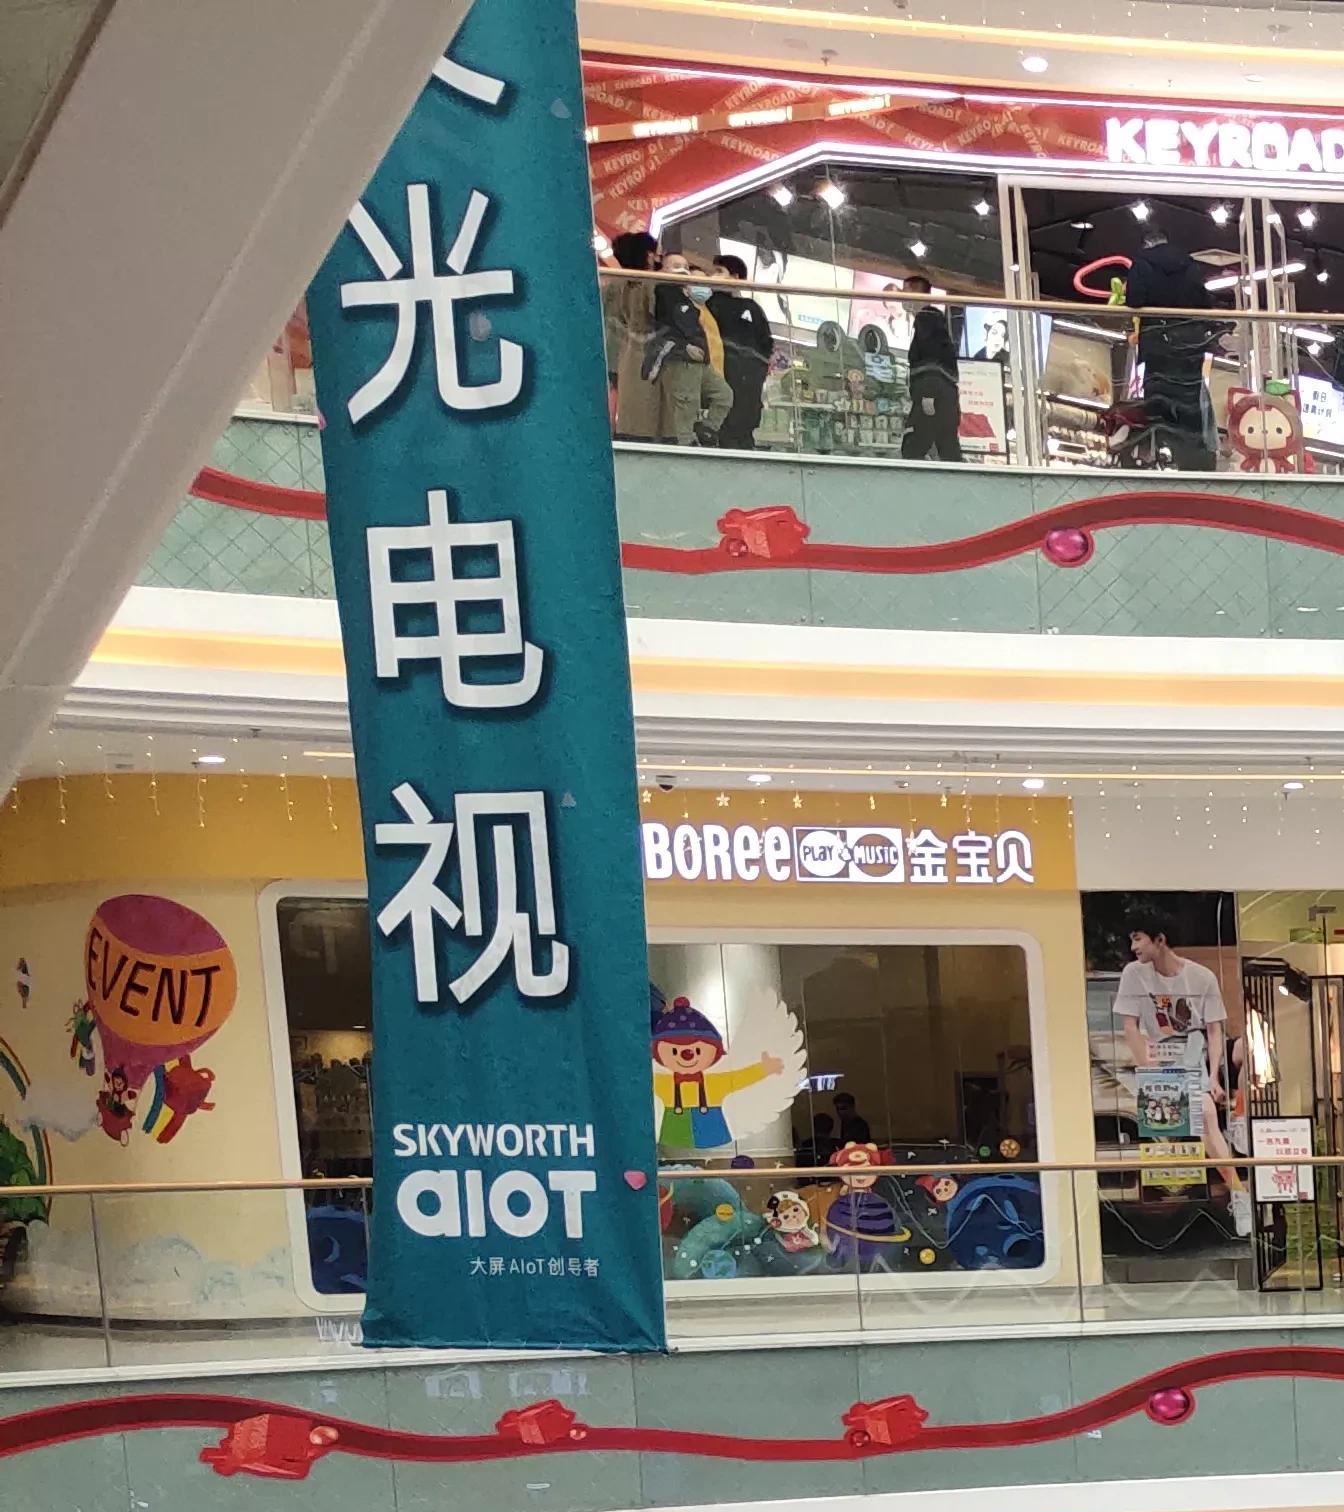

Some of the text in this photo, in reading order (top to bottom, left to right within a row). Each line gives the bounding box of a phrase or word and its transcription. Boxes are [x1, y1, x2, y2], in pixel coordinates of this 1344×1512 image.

[341, 52, 571, 1003] 光电视
[909, 829, 1035, 883] 金宝贝
[87, 927, 221, 1028] EVENT
[393, 1123, 595, 1157] SKYWORTH
[469, 1256, 600, 1277] 大屏 AIoT 创导者
